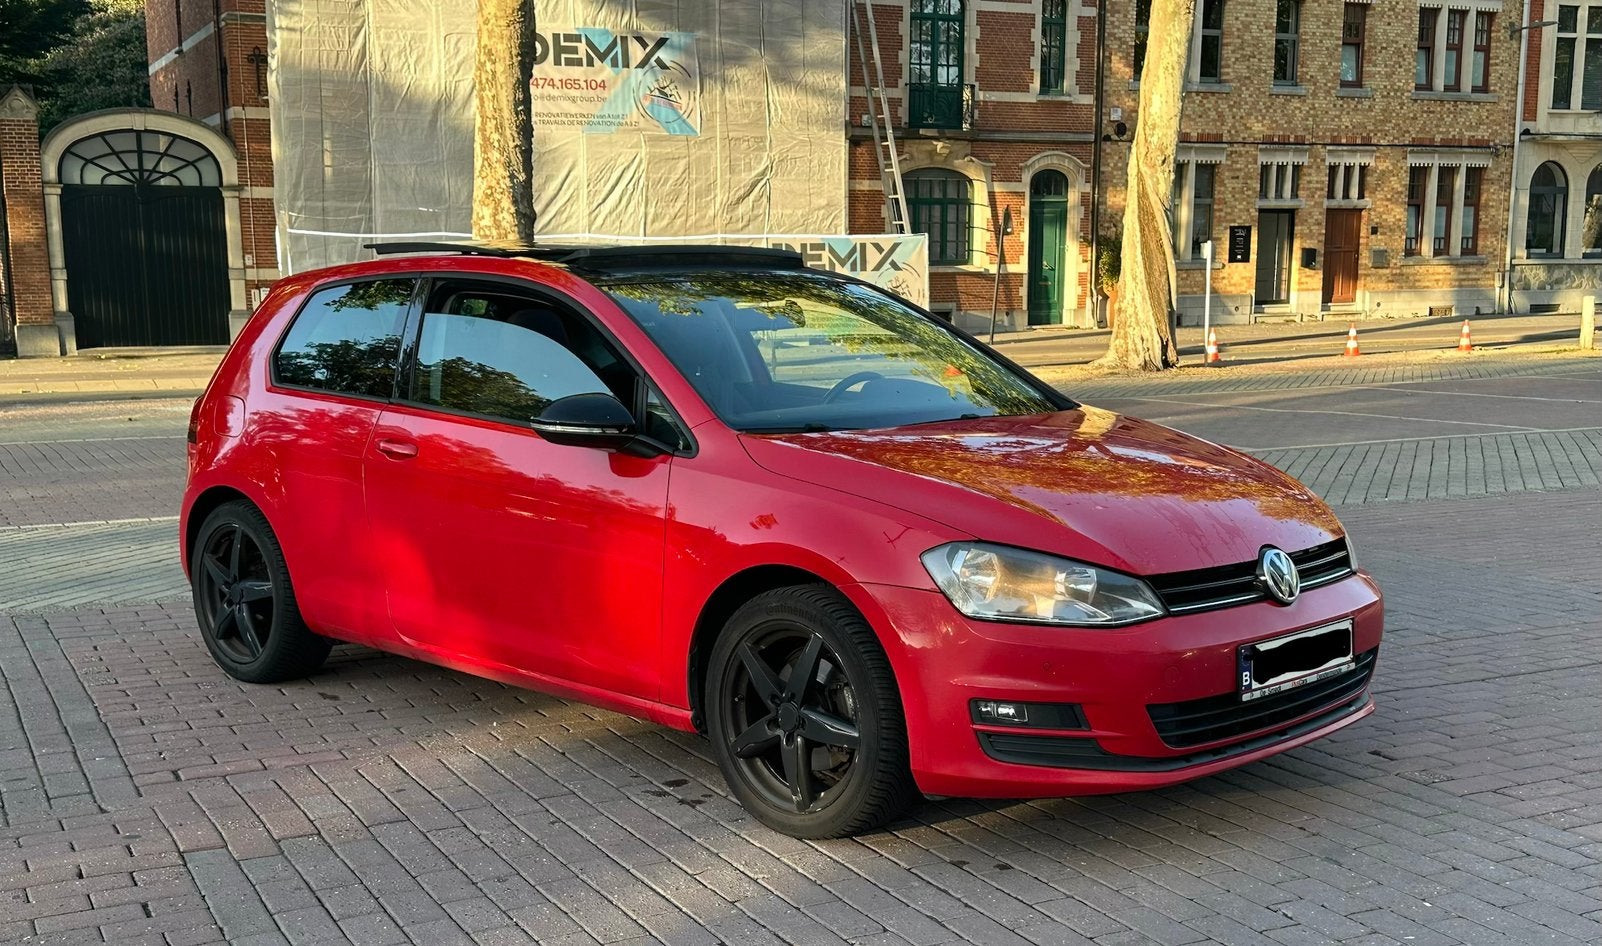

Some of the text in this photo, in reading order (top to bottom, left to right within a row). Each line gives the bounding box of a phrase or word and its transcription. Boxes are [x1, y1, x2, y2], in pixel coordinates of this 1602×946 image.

[531, 77, 607, 91] 474.165.104
[533, 93, 608, 103] o@demixgroup.be
[1242, 671, 1250, 686] B
